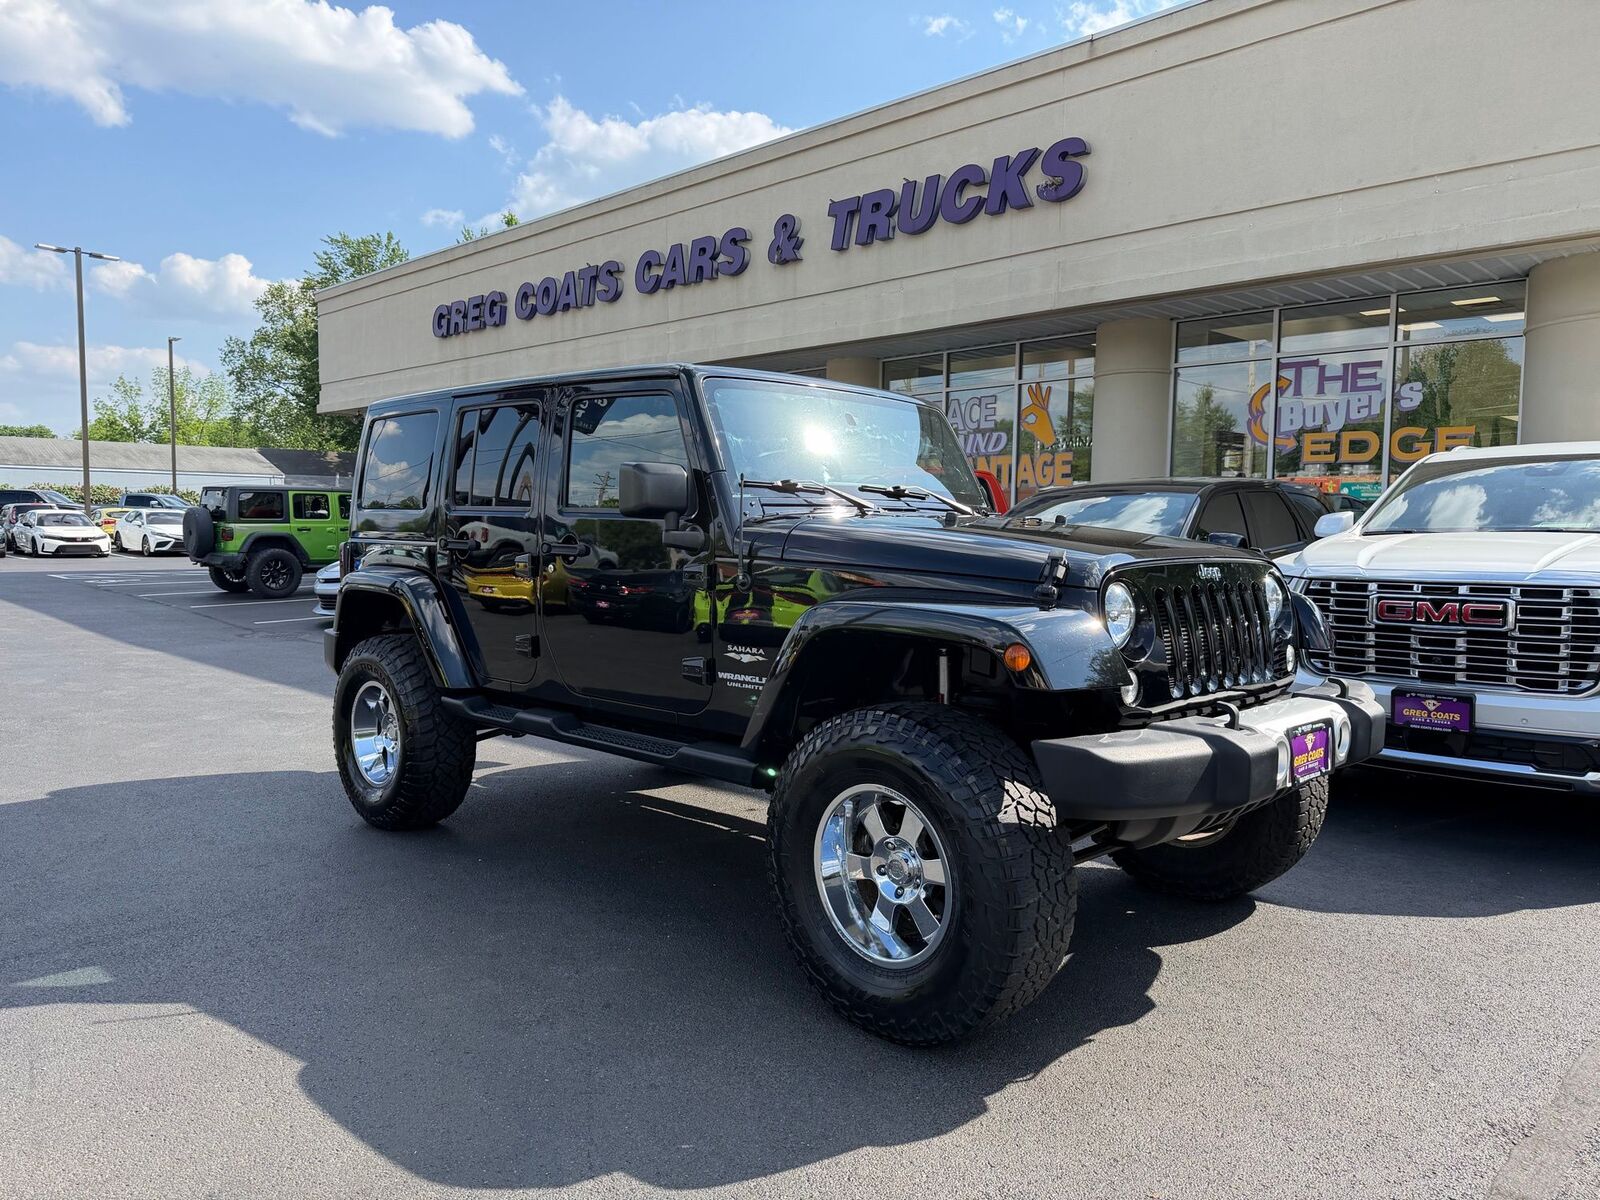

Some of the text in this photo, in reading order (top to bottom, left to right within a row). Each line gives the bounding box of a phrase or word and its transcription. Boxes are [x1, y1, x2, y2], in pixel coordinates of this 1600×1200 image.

[433, 137, 1092, 338] GREG COATS CARS & TRUCKS
[1279, 358, 1382, 397] THE
[946, 394, 997, 431] ACE
[959, 431, 1007, 457] IND
[967, 452, 1074, 488] NTAGE
[1198, 563, 1222, 581] Jeep
[1377, 599, 1504, 626] GMC
[727, 644, 765, 655] SAHARA
[717, 671, 767, 684] WRANGLE
[1403, 708, 1461, 721] GREG COATS
[1294, 753, 1308, 768] GREG
